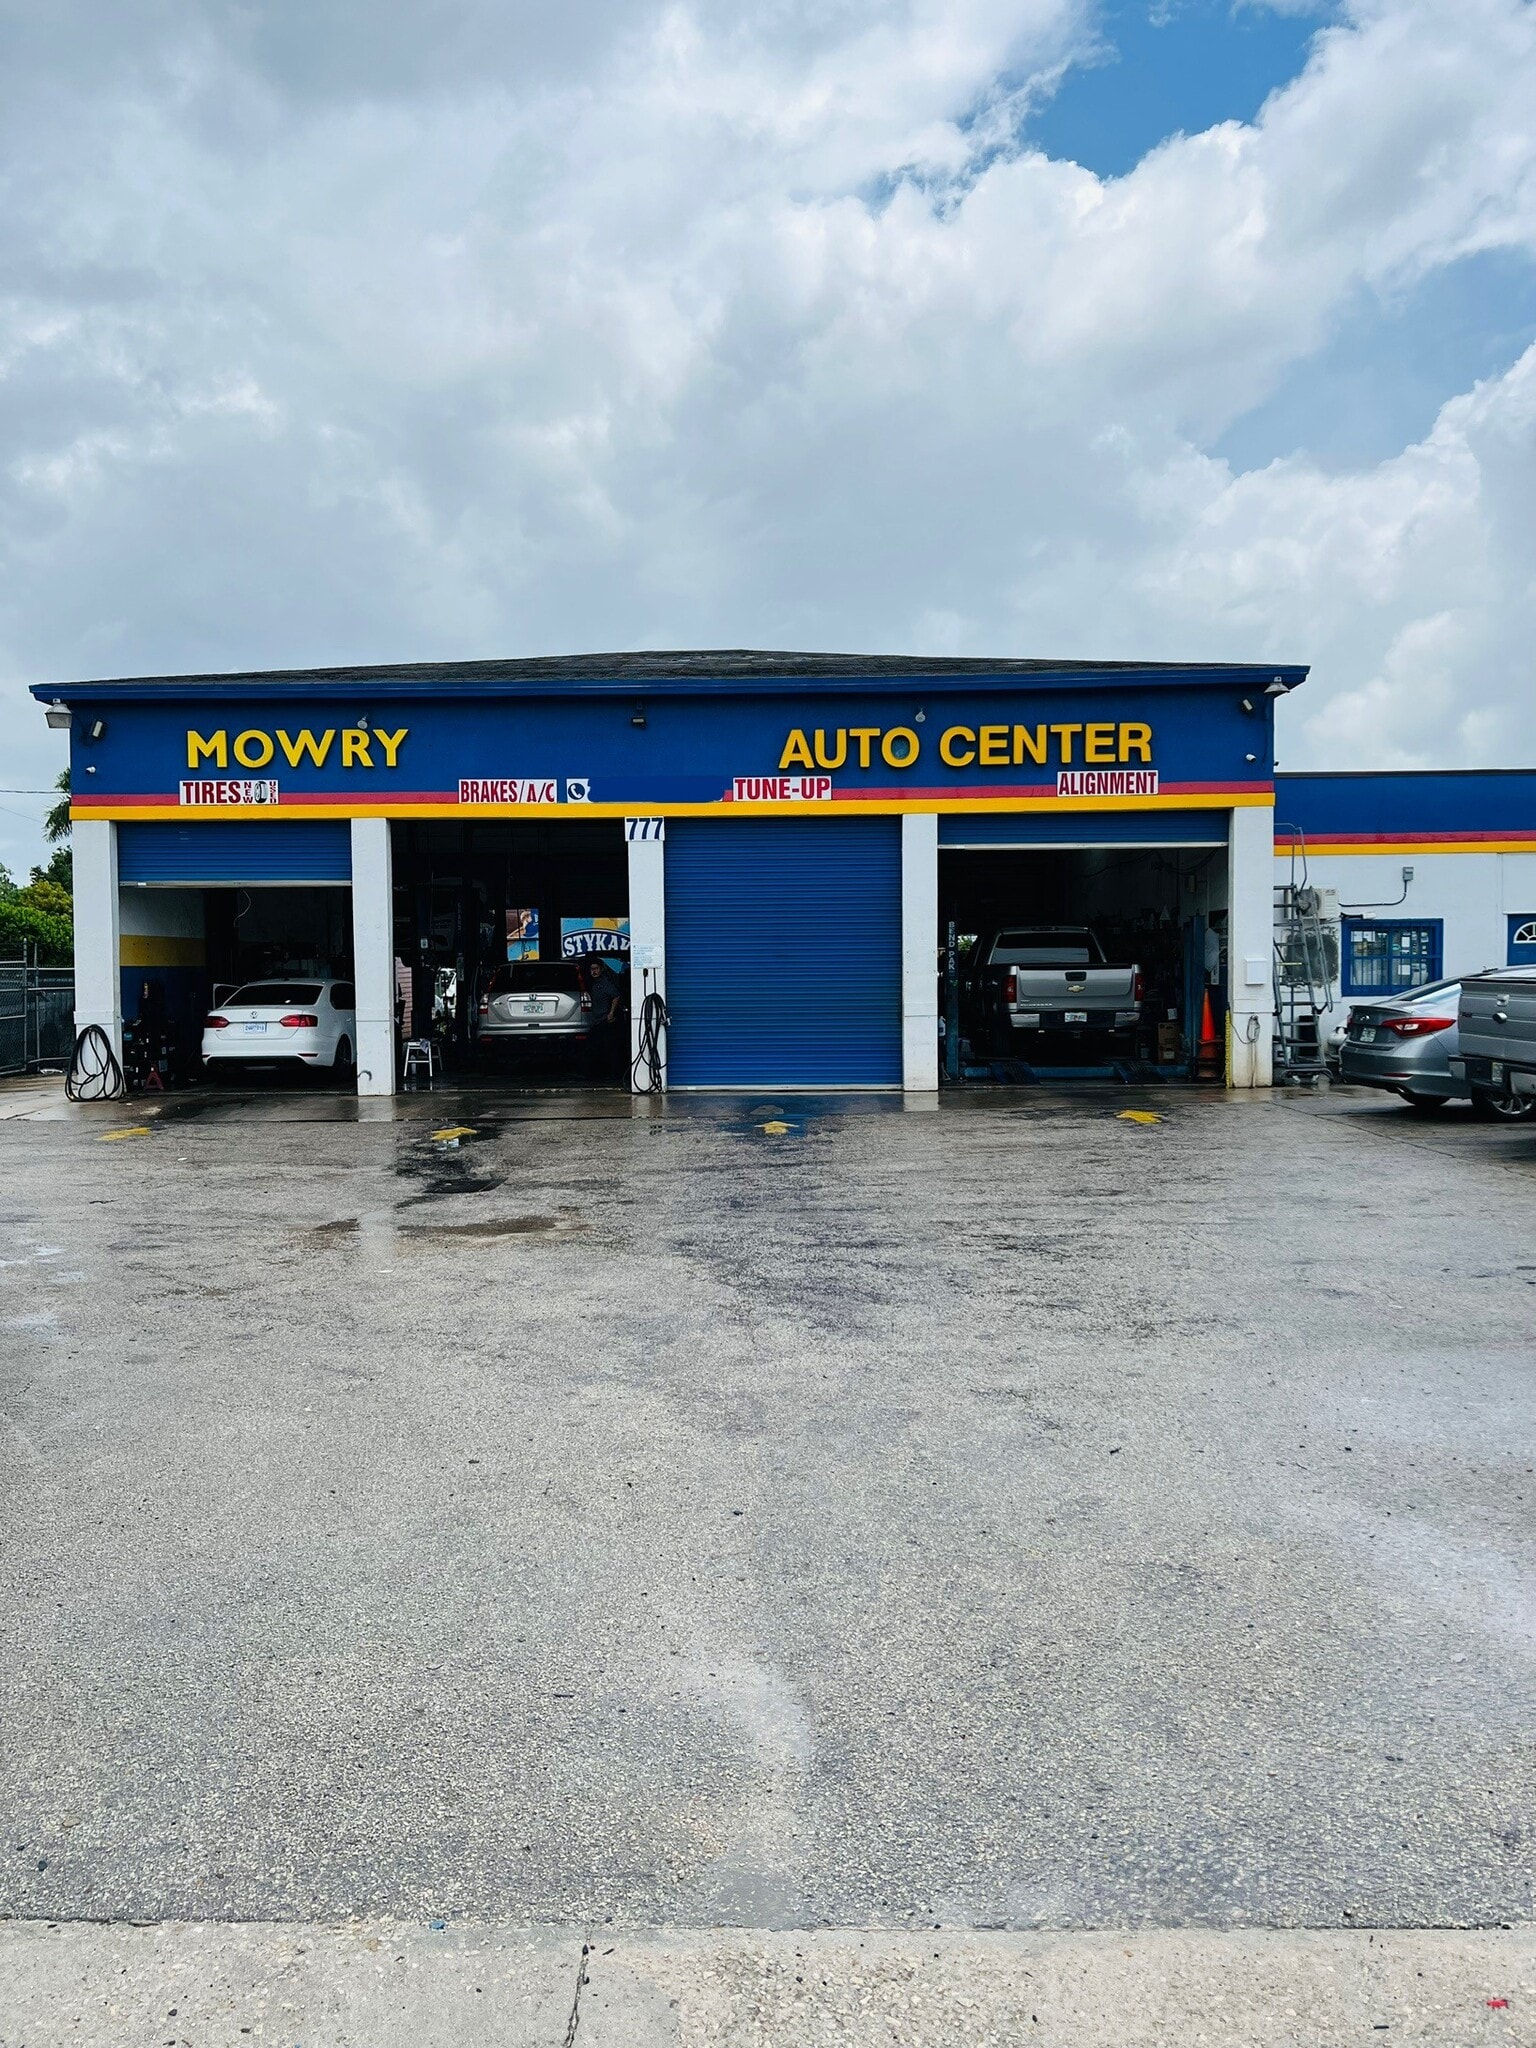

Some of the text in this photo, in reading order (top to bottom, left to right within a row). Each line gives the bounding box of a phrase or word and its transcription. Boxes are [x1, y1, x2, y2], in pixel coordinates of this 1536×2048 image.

[187, 729, 409, 768] MOWRY
[778, 722, 1153, 769] AUTO CENTER
[183, 781, 241, 804] TIRES
[243, 782, 253, 803] NEW
[734, 778, 830, 800] TUNE-UP
[1059, 772, 1157, 795] ALIGNMENT
[626, 817, 663, 840] 777
